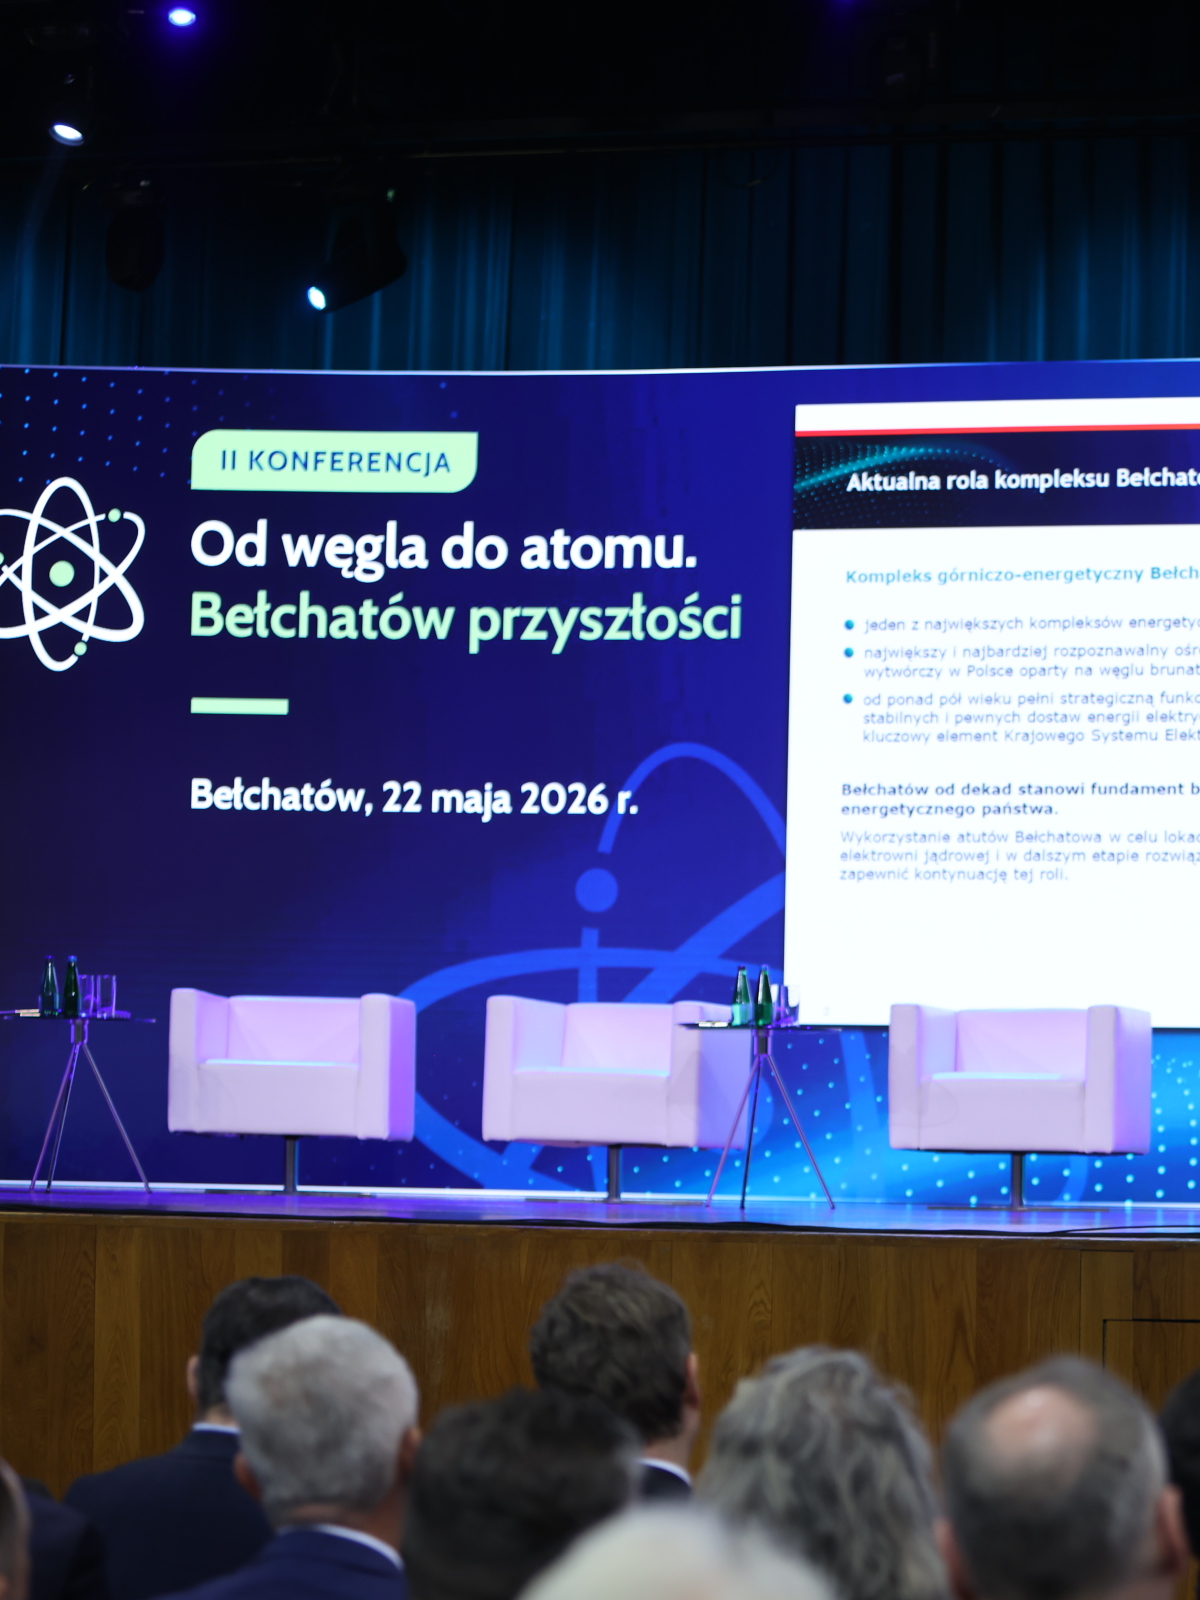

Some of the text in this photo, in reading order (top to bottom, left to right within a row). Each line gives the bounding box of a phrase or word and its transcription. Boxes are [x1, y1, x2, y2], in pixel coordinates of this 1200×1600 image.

[221, 449, 451, 478] II KONFERENCJA
[846, 470, 942, 492] Aktualna
[946, 469, 989, 490] rola
[994, 467, 1110, 494] kompleksu
[191, 519, 696, 582] Od węgla do atomu.
[846, 568, 933, 586] Kompleks
[937, 567, 1145, 586] górniczo-energetyczny
[191, 590, 741, 654] Bełchatów przyszłości
[864, 618, 906, 635] jeden
[924, 616, 1024, 634] największych
[1029, 615, 1124, 632] kompleksów
[864, 645, 947, 663] największy
[962, 644, 1048, 662] najbardziej
[1053, 643, 1169, 660] rozpoznawalny
[863, 664, 943, 681] wytwórczy
[966, 663, 1015, 678] Polsce
[1019, 664, 1069, 680] oparty
[1074, 665, 1094, 677] na
[1099, 663, 1145, 680] węglu
[863, 693, 882, 706] od
[887, 692, 934, 709] ponad
[939, 692, 963, 709] pół
[967, 692, 1013, 706] wieku
[1017, 691, 1054, 708] pełni
[1059, 692, 1155, 709] strategiczną
[863, 710, 940, 727] stabilnych
[954, 710, 1022, 727] pewnych
[1027, 710, 1082, 724] dostaw
[1087, 711, 1140, 727] energii
[862, 729, 932, 745] kluczowy
[936, 729, 999, 743] element
[1004, 729, 1085, 746] Krajowego
[1091, 728, 1159, 745] Systemu
[841, 782, 930, 796] Bełchatów
[934, 782, 956, 796] od
[960, 782, 1012, 796] dekad
[1018, 783, 1085, 796] stanowi
[1090, 781, 1185, 796] fundament
[191, 777, 639, 822] Bełchatów, 22 maja 2026 r.
[840, 801, 1059, 819] energetycznego państwa.
[840, 830, 952, 846] Wykorzystanie
[956, 830, 1009, 844] atutów
[1014, 829, 1103, 844] Bełchatowa
[1126, 830, 1159, 844] celu
[839, 848, 919, 862] elektrowni
[923, 848, 990, 866] jądrowej
[1023, 848, 1087, 864] dalszym
[1091, 849, 1140, 865] etapie
[839, 866, 1069, 884] zapewnić kontynuację tej roli.
